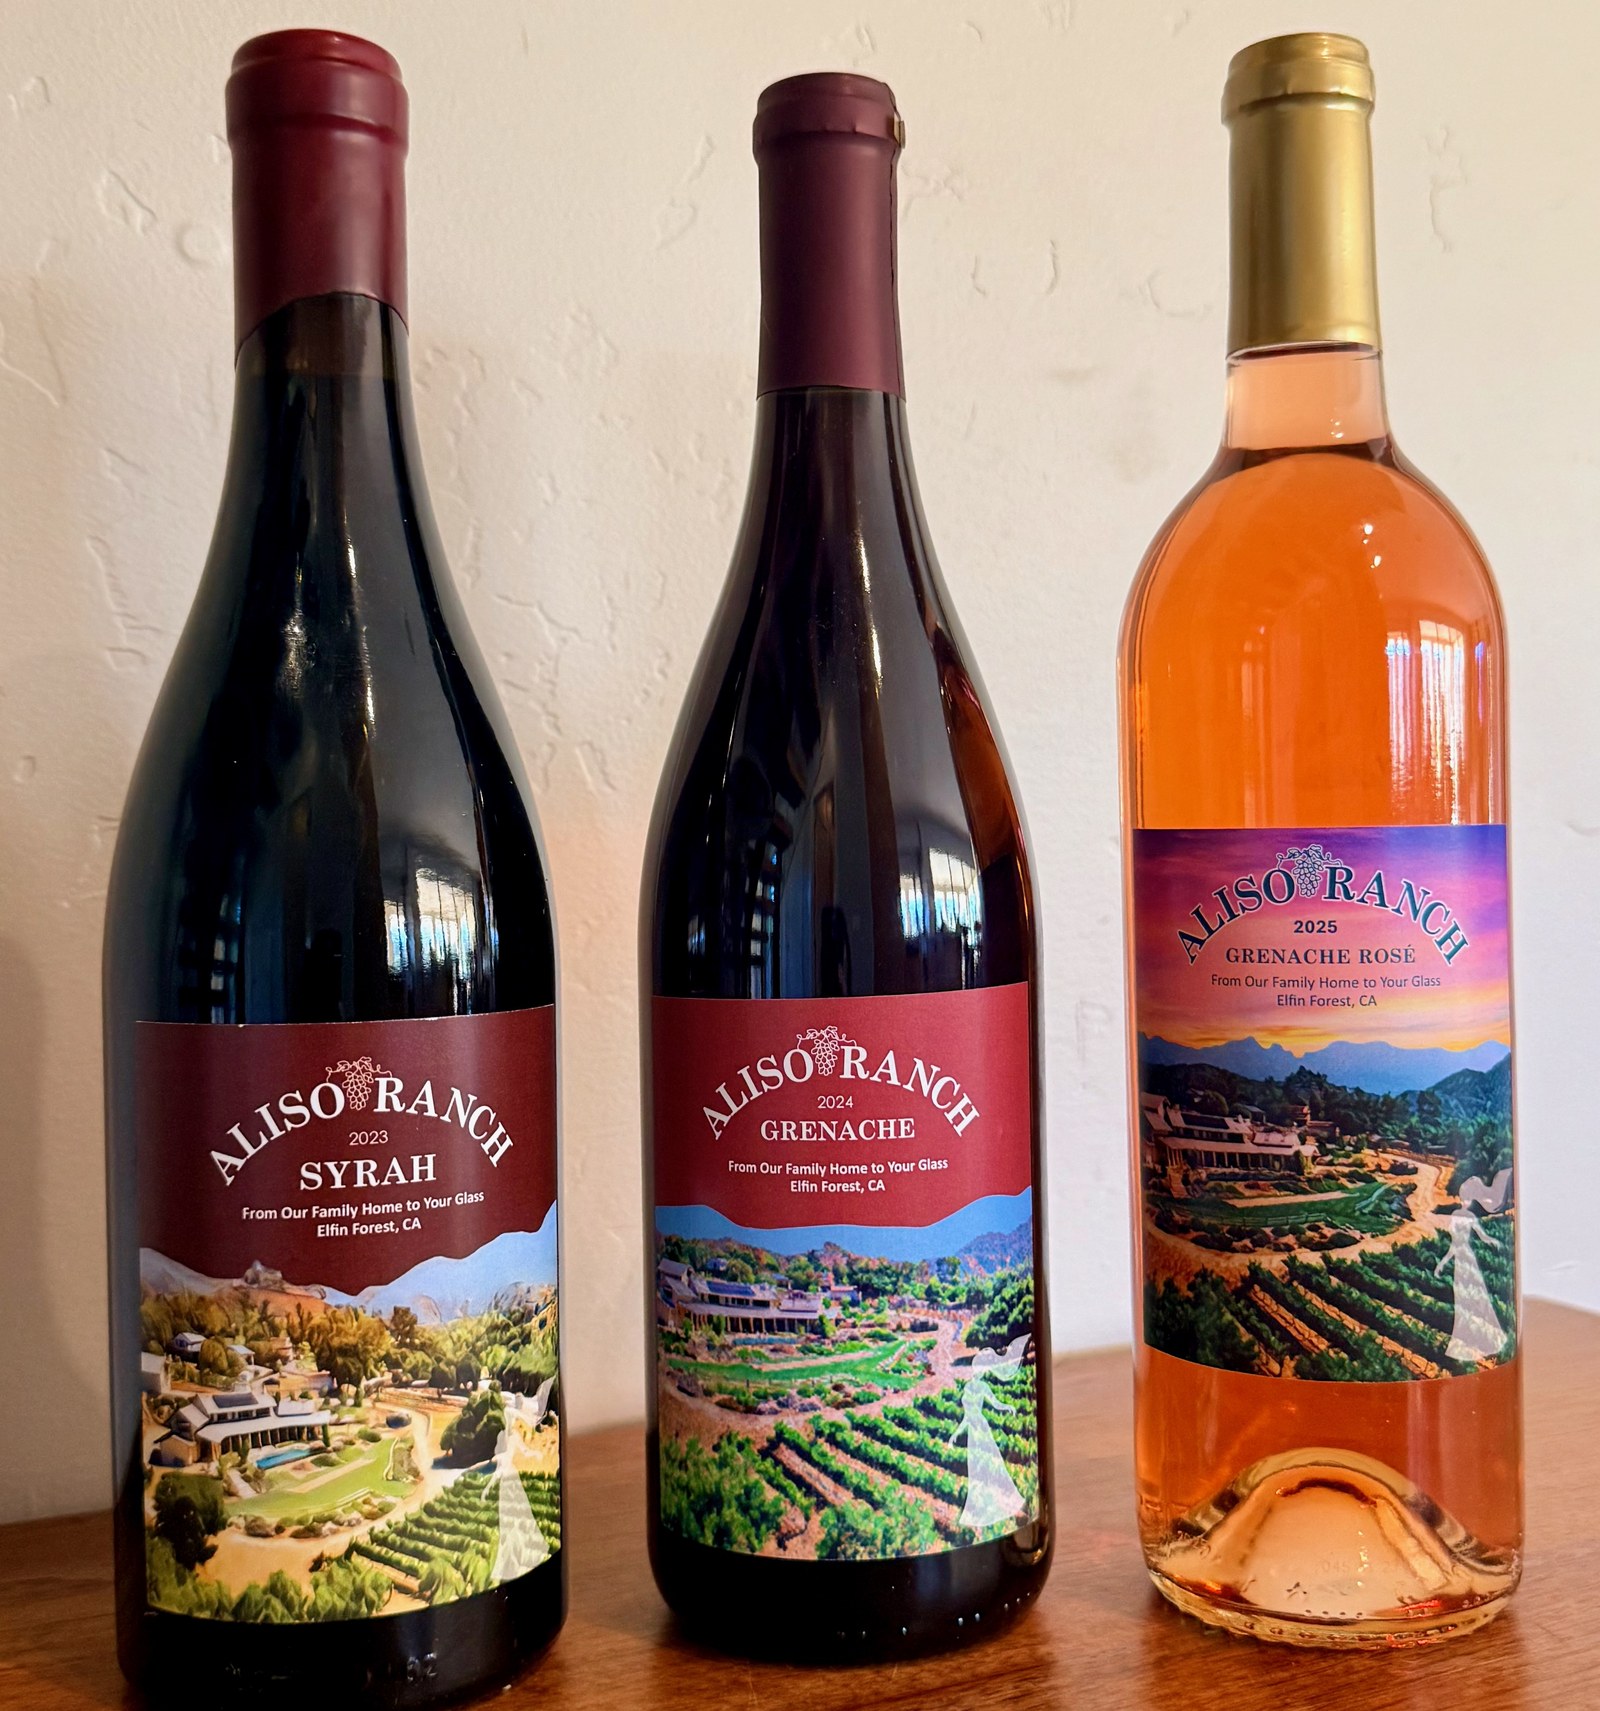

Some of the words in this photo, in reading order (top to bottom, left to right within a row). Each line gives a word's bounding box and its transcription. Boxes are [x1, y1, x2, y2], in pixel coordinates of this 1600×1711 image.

[1177, 868, 1295, 964] ALISO
[1324, 866, 1469, 965] RANCH
[1294, 921, 1337, 934] 2025
[1226, 948, 1350, 964] GRENACHE
[1358, 945, 1415, 964] ROSÉ
[1212, 974, 1241, 986] From
[1245, 976, 1267, 987] Our
[1273, 976, 1315, 990] Family
[1320, 977, 1359, 988] Home
[1364, 978, 1376, 988] to
[1380, 976, 1408, 987] Your
[1411, 975, 1440, 987] Glass
[1277, 995, 1305, 1006] Elfin
[1310, 995, 1355, 1007] Forest,
[1359, 995, 1376, 1006] CA
[702, 1049, 813, 1140] ALISO
[840, 1046, 980, 1136] RANCH
[817, 1096, 853, 1109] 2024
[210, 1082, 344, 1186] ALISO
[374, 1077, 513, 1167] RANCH
[349, 1130, 388, 1146] 2023
[760, 1118, 915, 1141] GRENACHE
[300, 1154, 436, 1190] SYRAH
[728, 1160, 756, 1173] From
[760, 1162, 782, 1174] Our
[786, 1162, 826, 1177] Family
[830, 1162, 868, 1174] Home
[872, 1163, 884, 1173] to
[888, 1159, 915, 1173] Your
[918, 1158, 948, 1171] Glass
[791, 1180, 817, 1192] Elfin
[822, 1180, 864, 1194] Forest,
[868, 1180, 885, 1191] CA
[242, 1207, 277, 1221] From
[281, 1205, 307, 1219] Our
[312, 1203, 358, 1219] Family
[363, 1200, 402, 1215] Home
[407, 1200, 420, 1212] to
[423, 1196, 452, 1210] Your
[455, 1191, 484, 1205] Glass
[317, 1223, 348, 1237] Elfin
[352, 1220, 398, 1235] Forest,
[403, 1217, 421, 1231] CA
